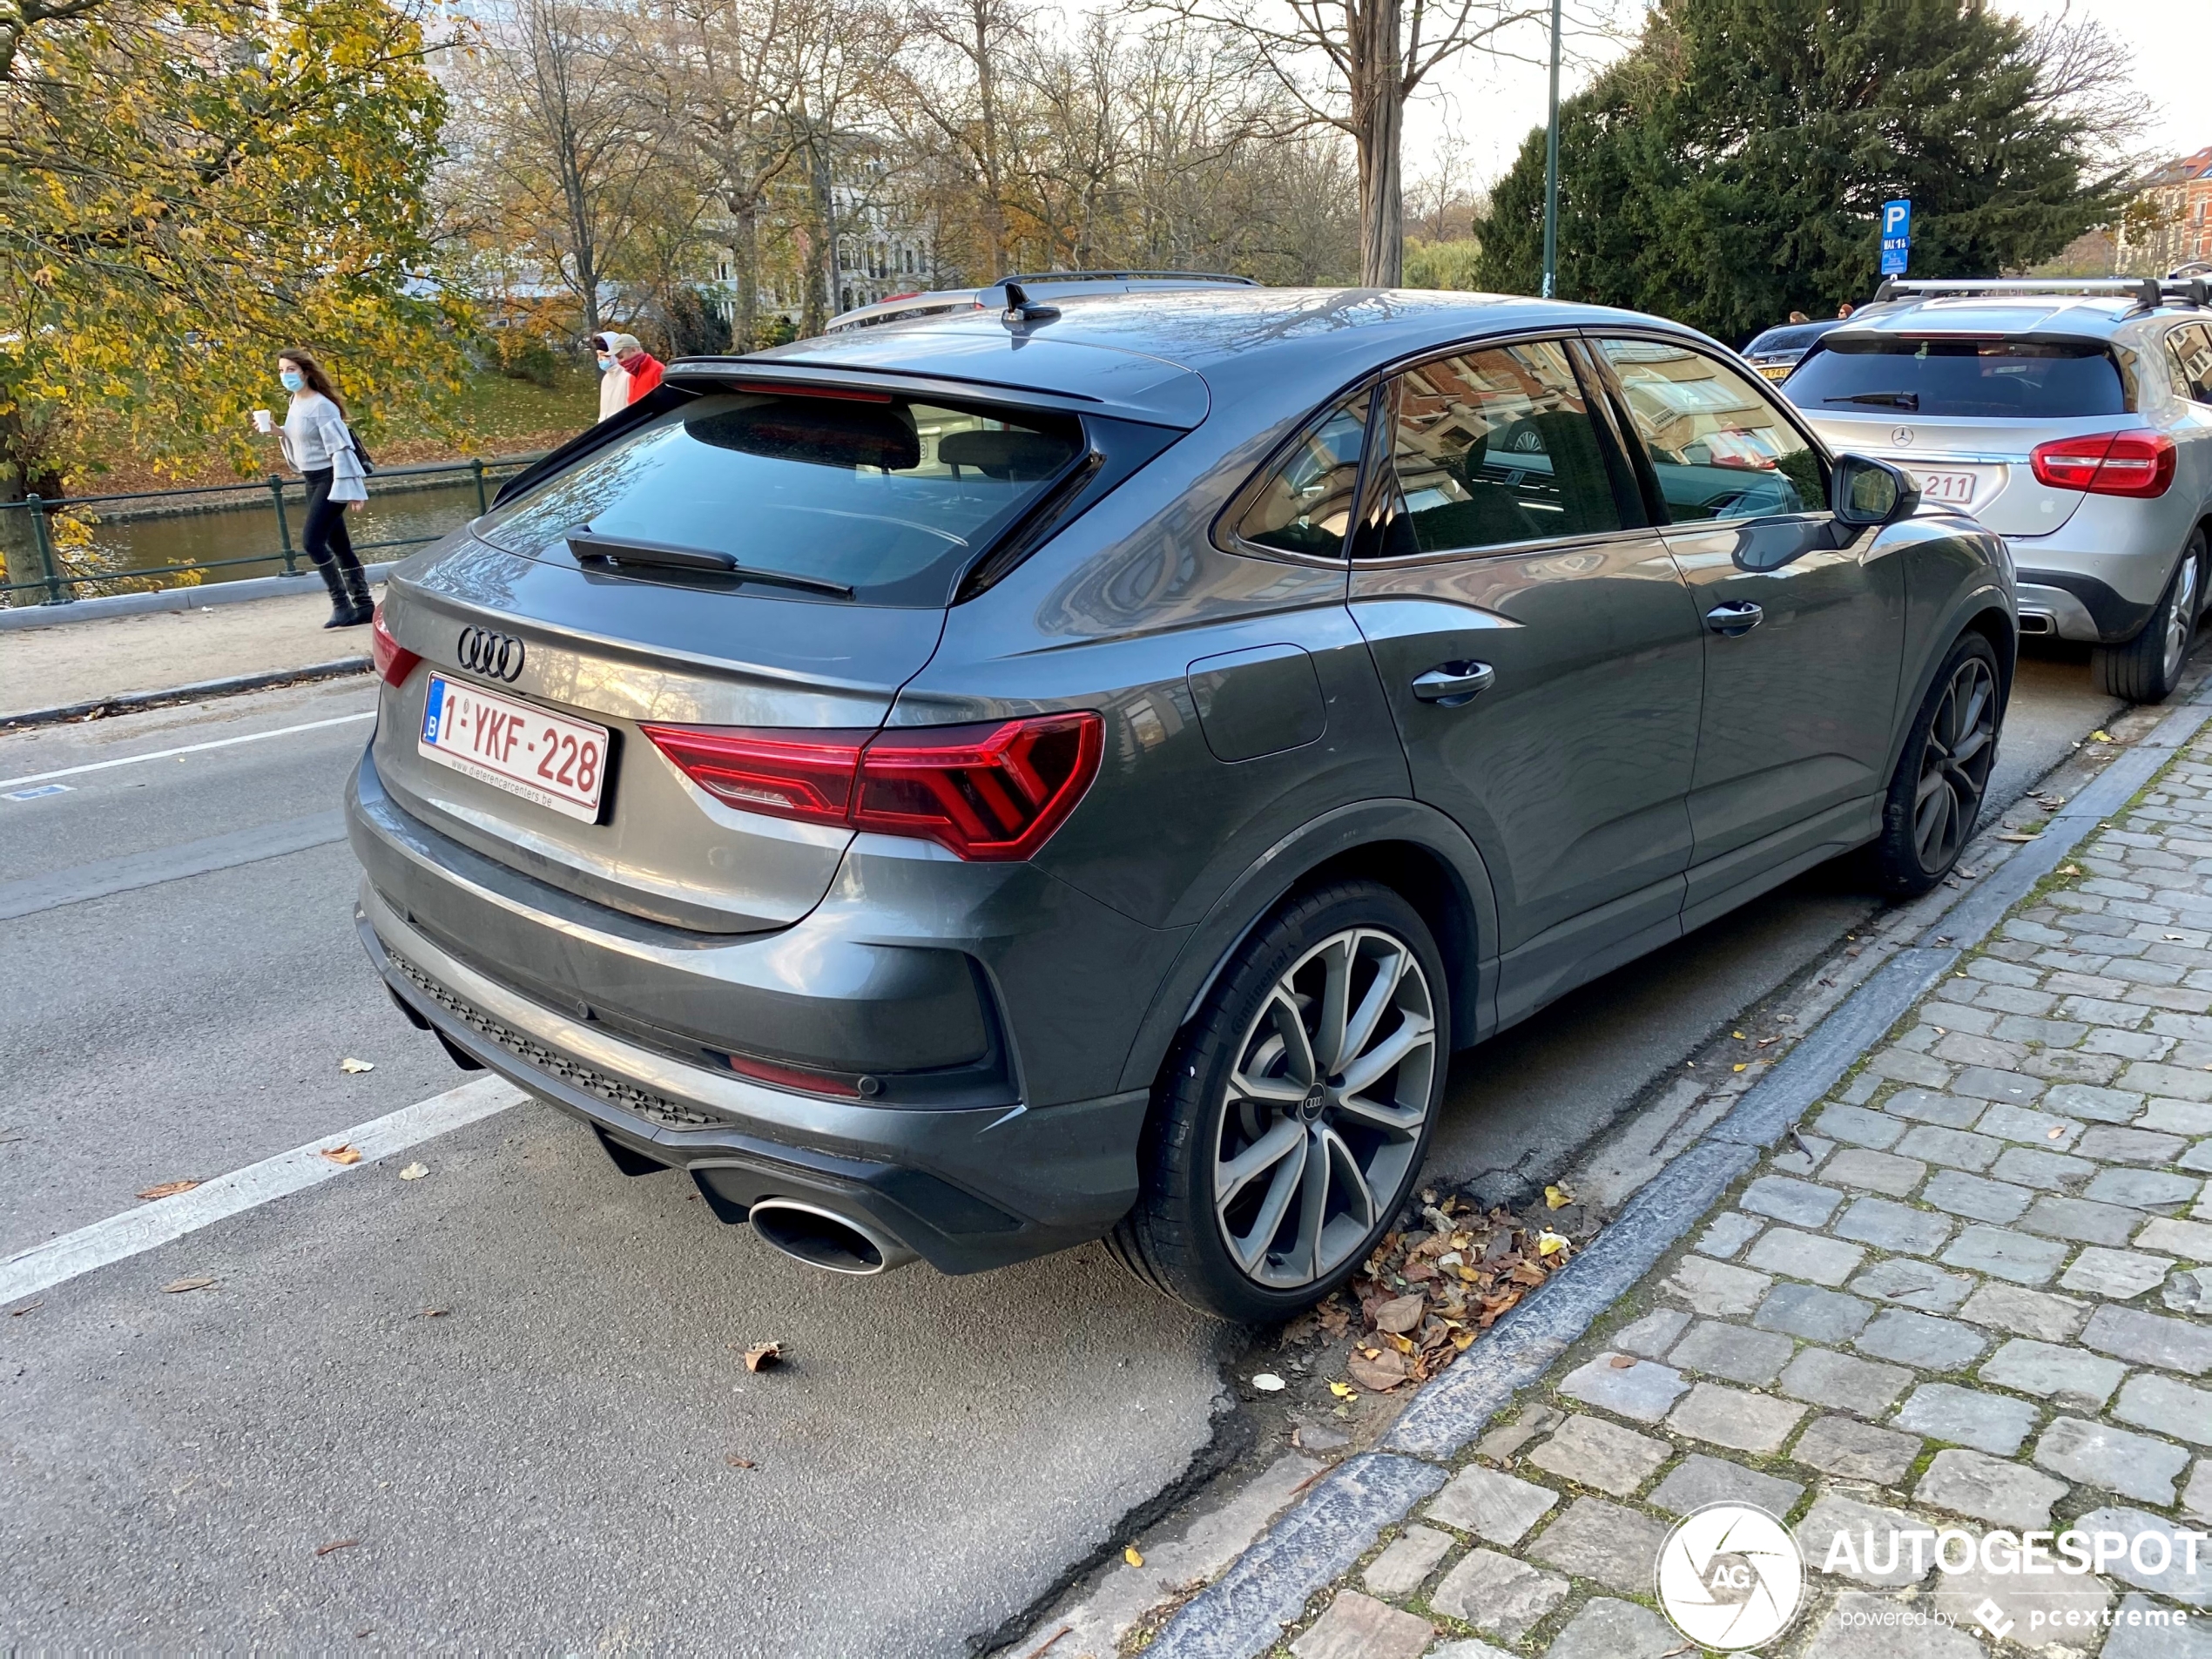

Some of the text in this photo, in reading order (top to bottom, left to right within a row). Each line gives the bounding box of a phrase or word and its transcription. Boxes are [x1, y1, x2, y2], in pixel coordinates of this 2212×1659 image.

[1886, 206, 1905, 233] P
[428, 715, 437, 737] B
[444, 694, 598, 792] 1-YKF-228
[451, 759, 552, 807] www.dieterencarcenters.be
